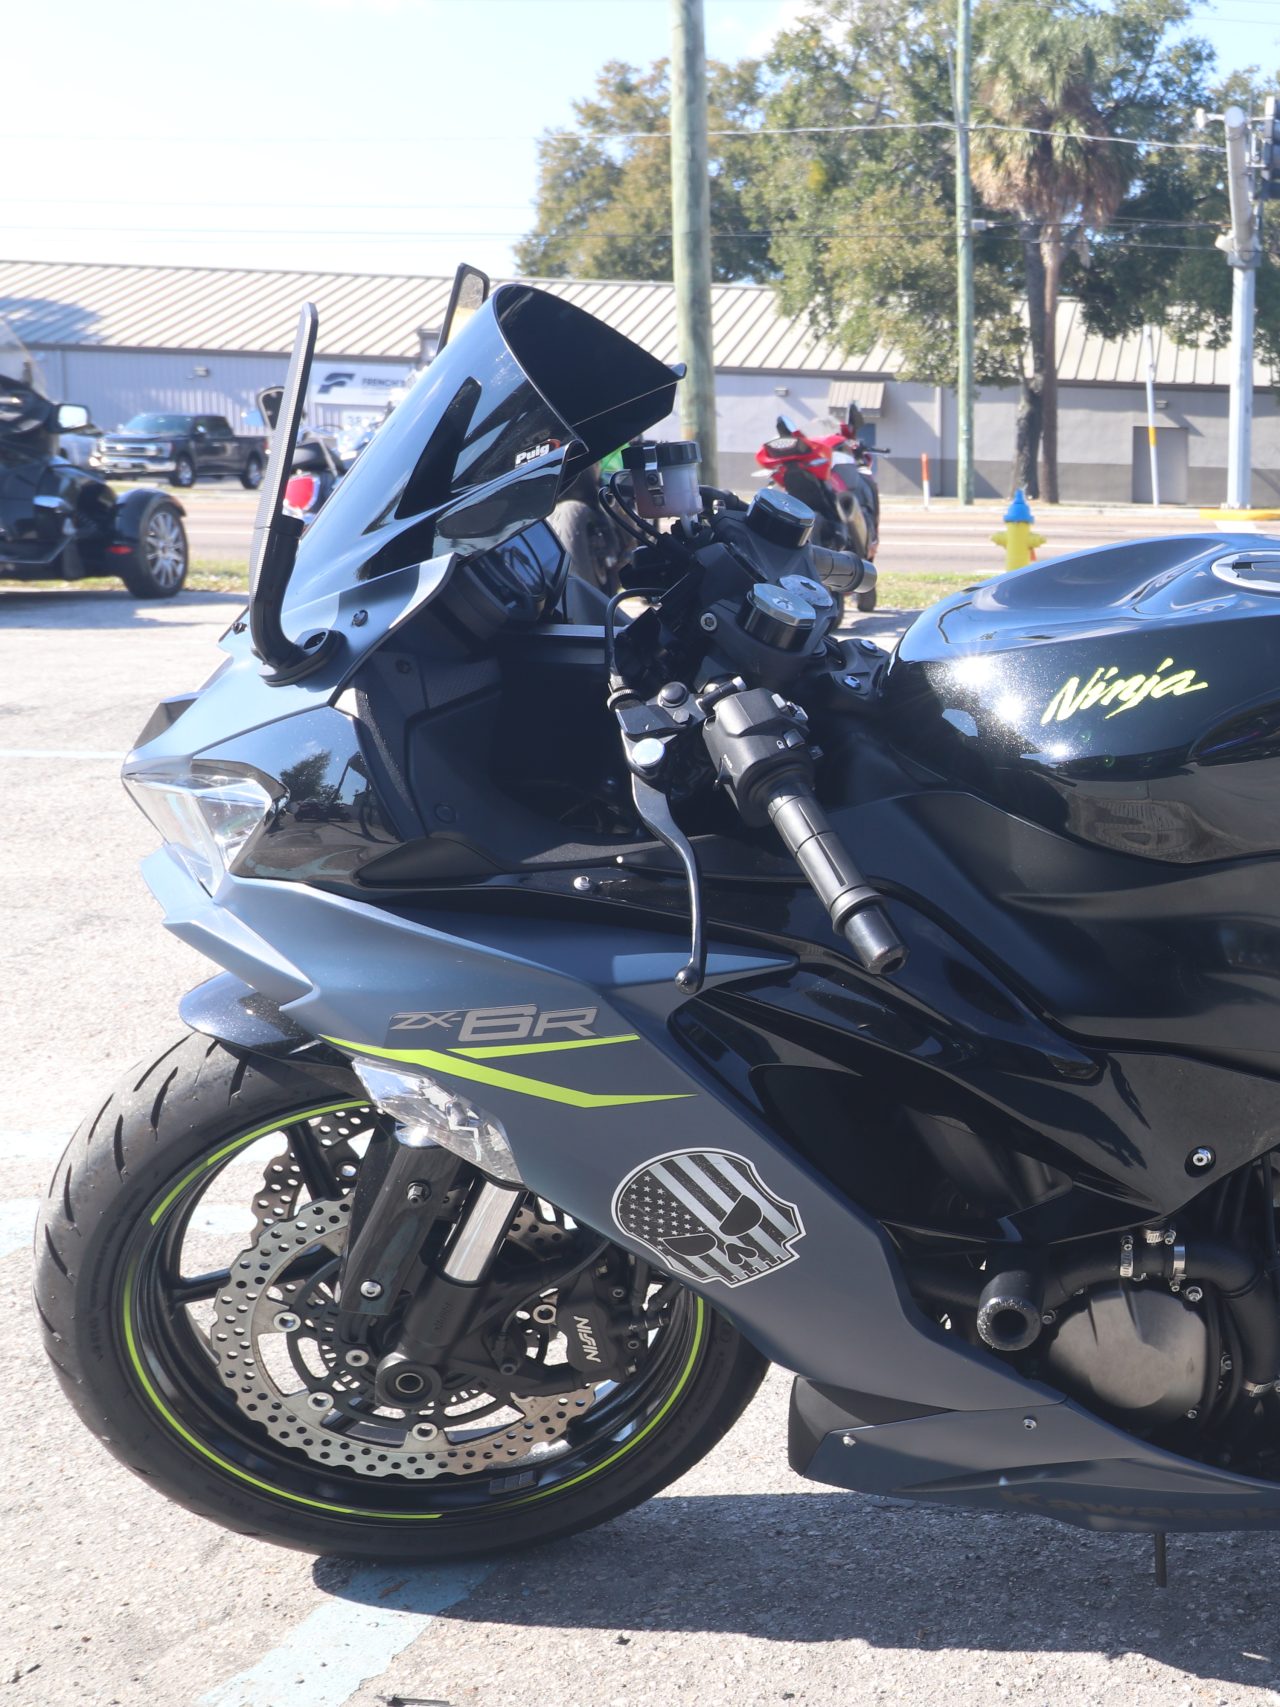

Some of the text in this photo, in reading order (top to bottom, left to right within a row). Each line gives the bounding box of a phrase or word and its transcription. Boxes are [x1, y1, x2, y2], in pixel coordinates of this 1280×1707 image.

[515, 443, 550, 465] Puig
[1040, 658, 1208, 725] Ninja
[391, 1004, 598, 1042] ZX-6R
[573, 1316, 601, 1362] NISSIN
